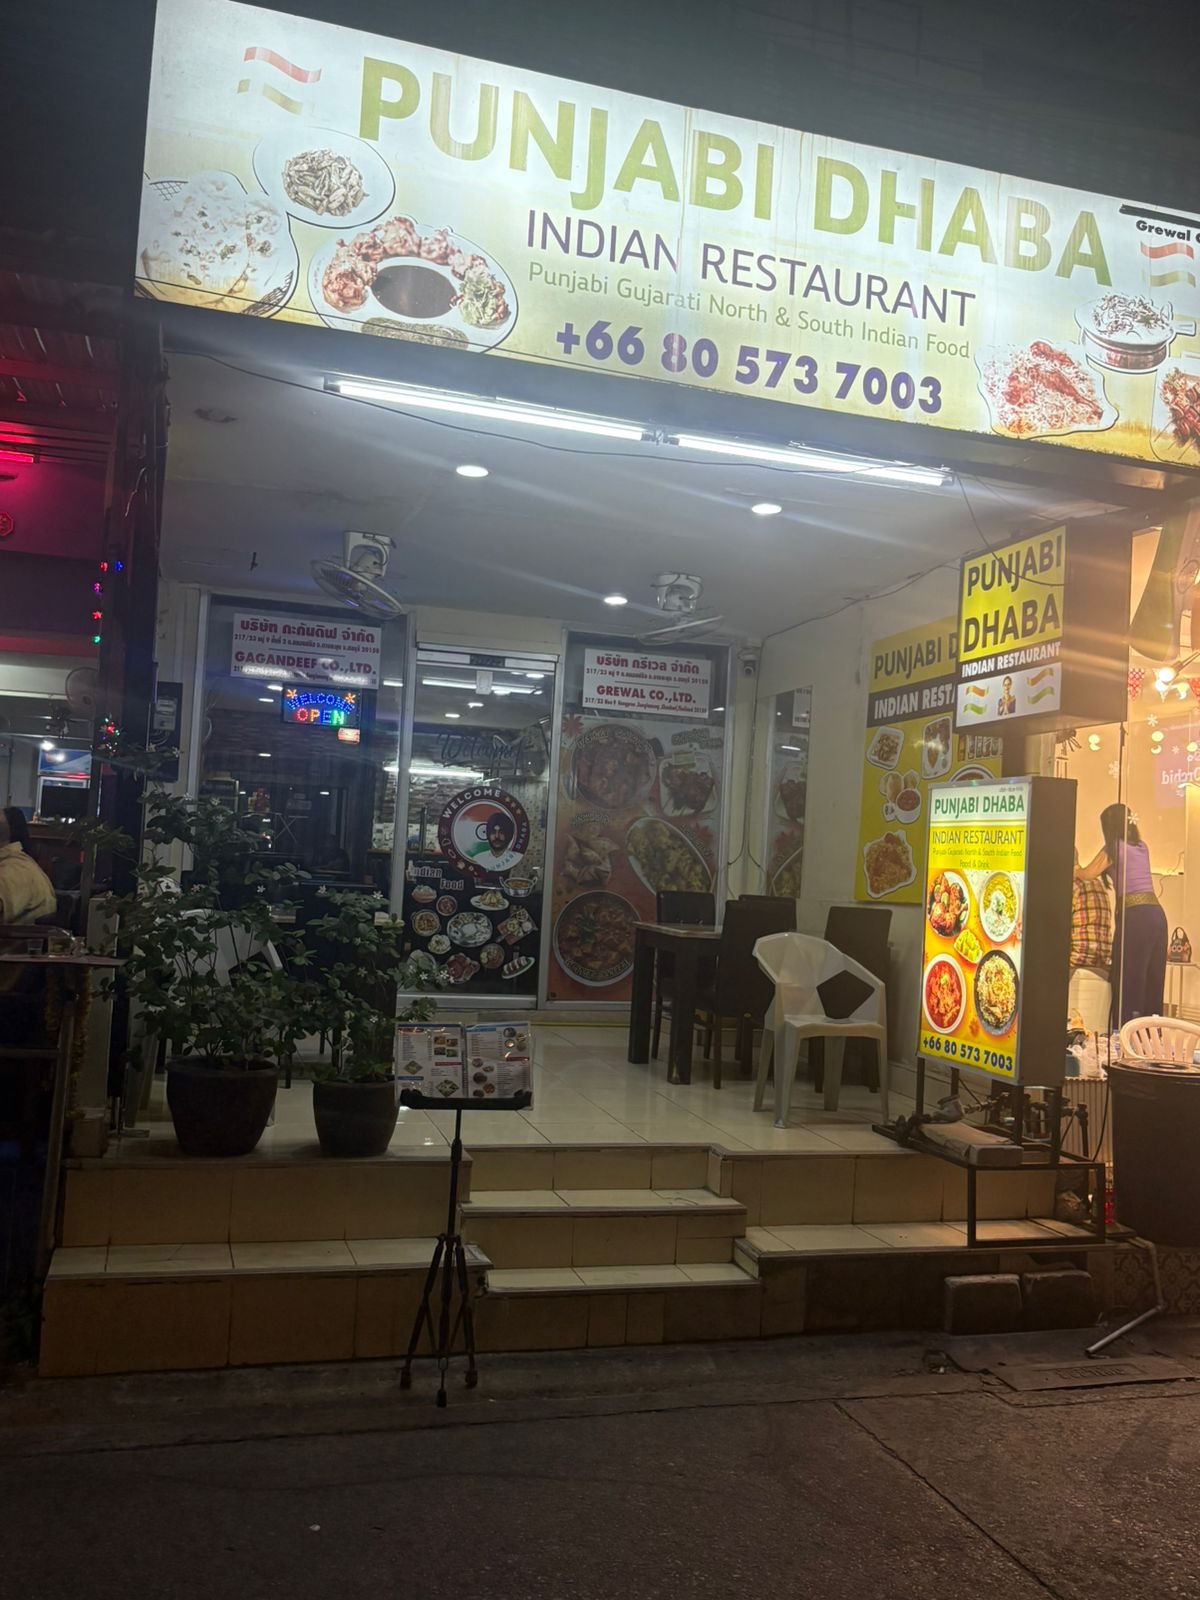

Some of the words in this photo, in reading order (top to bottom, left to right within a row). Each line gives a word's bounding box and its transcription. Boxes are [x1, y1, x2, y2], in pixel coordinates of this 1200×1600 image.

[358, 56, 775, 221] PUNJABI
[813, 155, 1113, 287] DHABA
[1136, 219, 1191, 241] Grewal
[526, 209, 679, 274] INDIAN
[700, 243, 977, 328] RESTAURANT
[528, 261, 610, 297] Punjabi
[616, 276, 701, 312] Gujarati
[708, 296, 768, 324] North
[774, 306, 791, 328] &
[797, 310, 854, 338] South
[861, 322, 919, 349] Indian
[925, 329, 971, 359] Food
[556, 321, 646, 366] +66
[661, 332, 719, 378] 80
[734, 347, 819, 394] 573
[835, 363, 943, 415] 7003
[966, 534, 1063, 597] PUNJABI
[963, 593, 1061, 653] DHABA
[873, 636, 942, 680] PUNJABI
[961, 656, 995, 678] INDIAN
[996, 641, 1062, 670] RESTAURANT
[287, 692, 355, 715] WELCOME
[596, 685, 646, 699] GREWAL
[873, 694, 919, 720] INDIAN
[296, 707, 345, 725] OPEN
[442, 788, 501, 819] WELCOME
[934, 797, 979, 818] PUNJABI
[983, 795, 1025, 812] DHABA
[932, 830, 961, 845] INDIAN
[963, 830, 1025, 845] RESTAURANT
[922, 1035, 942, 1051] +66
[944, 1040, 957, 1055] 80
[960, 1044, 981, 1062] 573
[983, 1050, 1013, 1071] 7003
